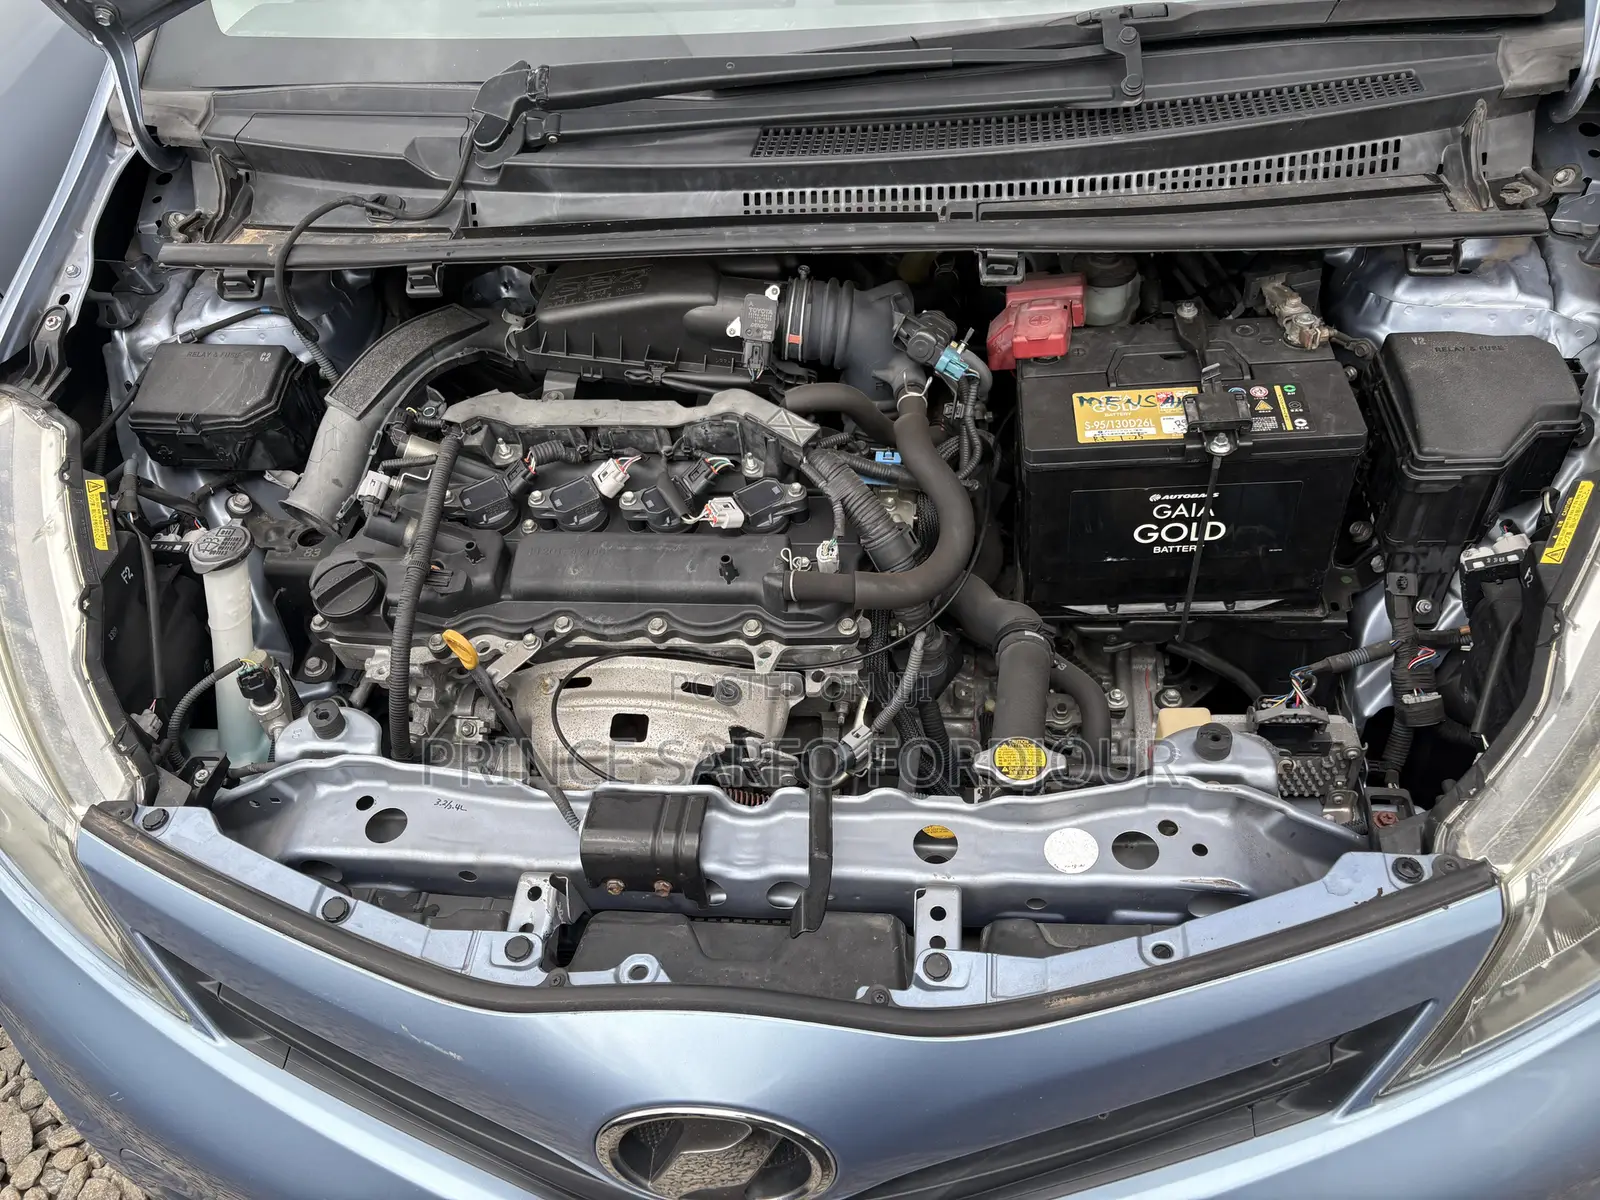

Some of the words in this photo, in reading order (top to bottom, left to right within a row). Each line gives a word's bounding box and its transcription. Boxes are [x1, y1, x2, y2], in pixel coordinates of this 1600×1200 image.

[1434, 345, 1465, 353] RELAY
[1084, 418, 1156, 431] S-95/130D26L
[1160, 492, 1220, 501] AUTOBAS
[1133, 521, 1227, 544] GOLD
[1153, 544, 1205, 554] BATTER
